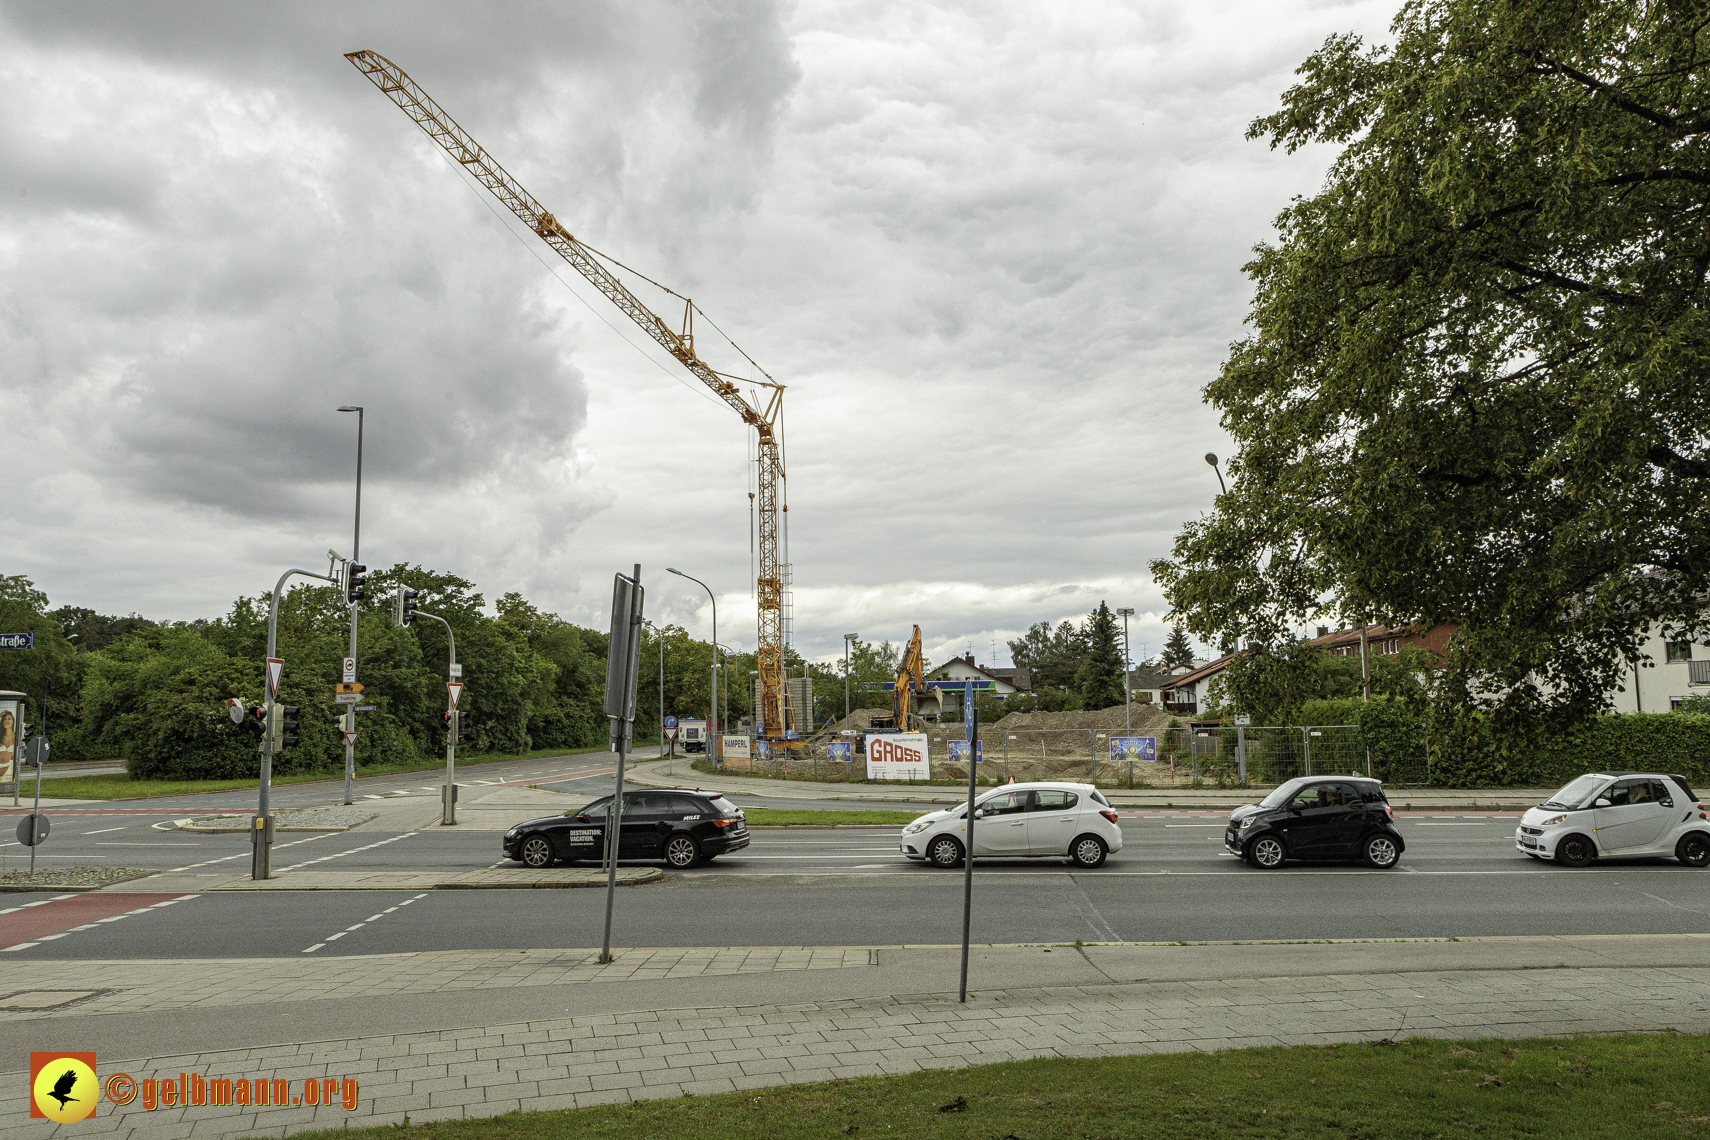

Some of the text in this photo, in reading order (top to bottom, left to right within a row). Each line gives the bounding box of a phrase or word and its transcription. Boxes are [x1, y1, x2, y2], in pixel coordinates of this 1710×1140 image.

[0, 635, 26, 647] traße
[724, 739, 748, 748] HAMPERL
[870, 738, 921, 762] GROSS
